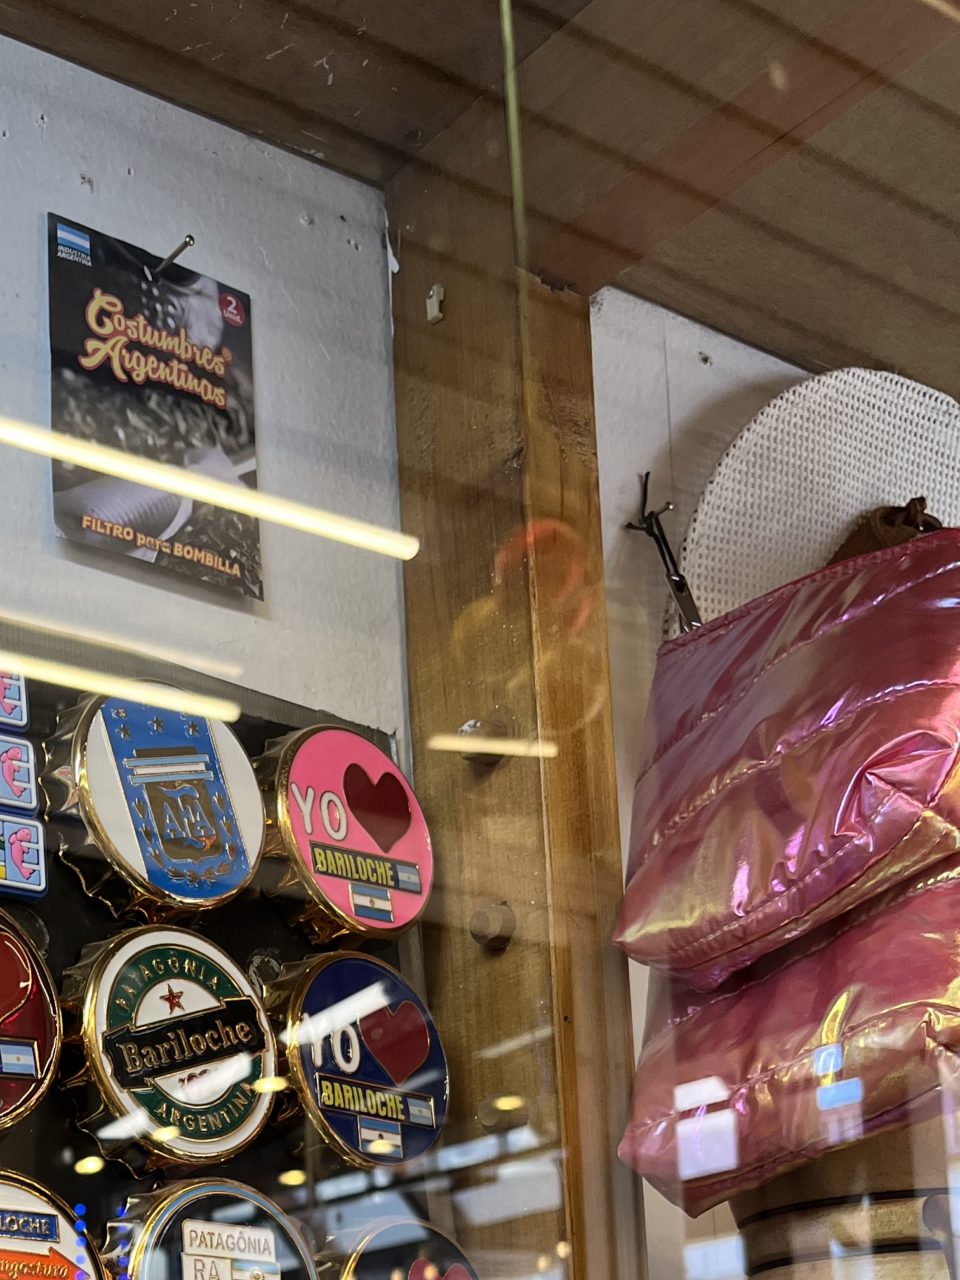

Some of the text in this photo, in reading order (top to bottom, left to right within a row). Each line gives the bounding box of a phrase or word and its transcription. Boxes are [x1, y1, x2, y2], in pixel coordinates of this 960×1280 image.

[56, 251, 92, 267] ARGENTINA
[85, 288, 227, 377] Costumbres
[226, 296, 237, 314] 2
[78, 335, 227, 410] Argentinas
[82, 515, 134, 542] FILTRO
[173, 543, 241, 578] BOMBILLA
[291, 781, 348, 842] YO
[314, 846, 395, 888] BARILOCHE
[117, 1018, 254, 1075] Bariloche
[302, 1012, 362, 1075] YO
[155, 1081, 256, 1134] ARGENTINA
[320, 1080, 406, 1121] BARILOCHE
[189, 1227, 272, 1257] PATAGÔNIA
